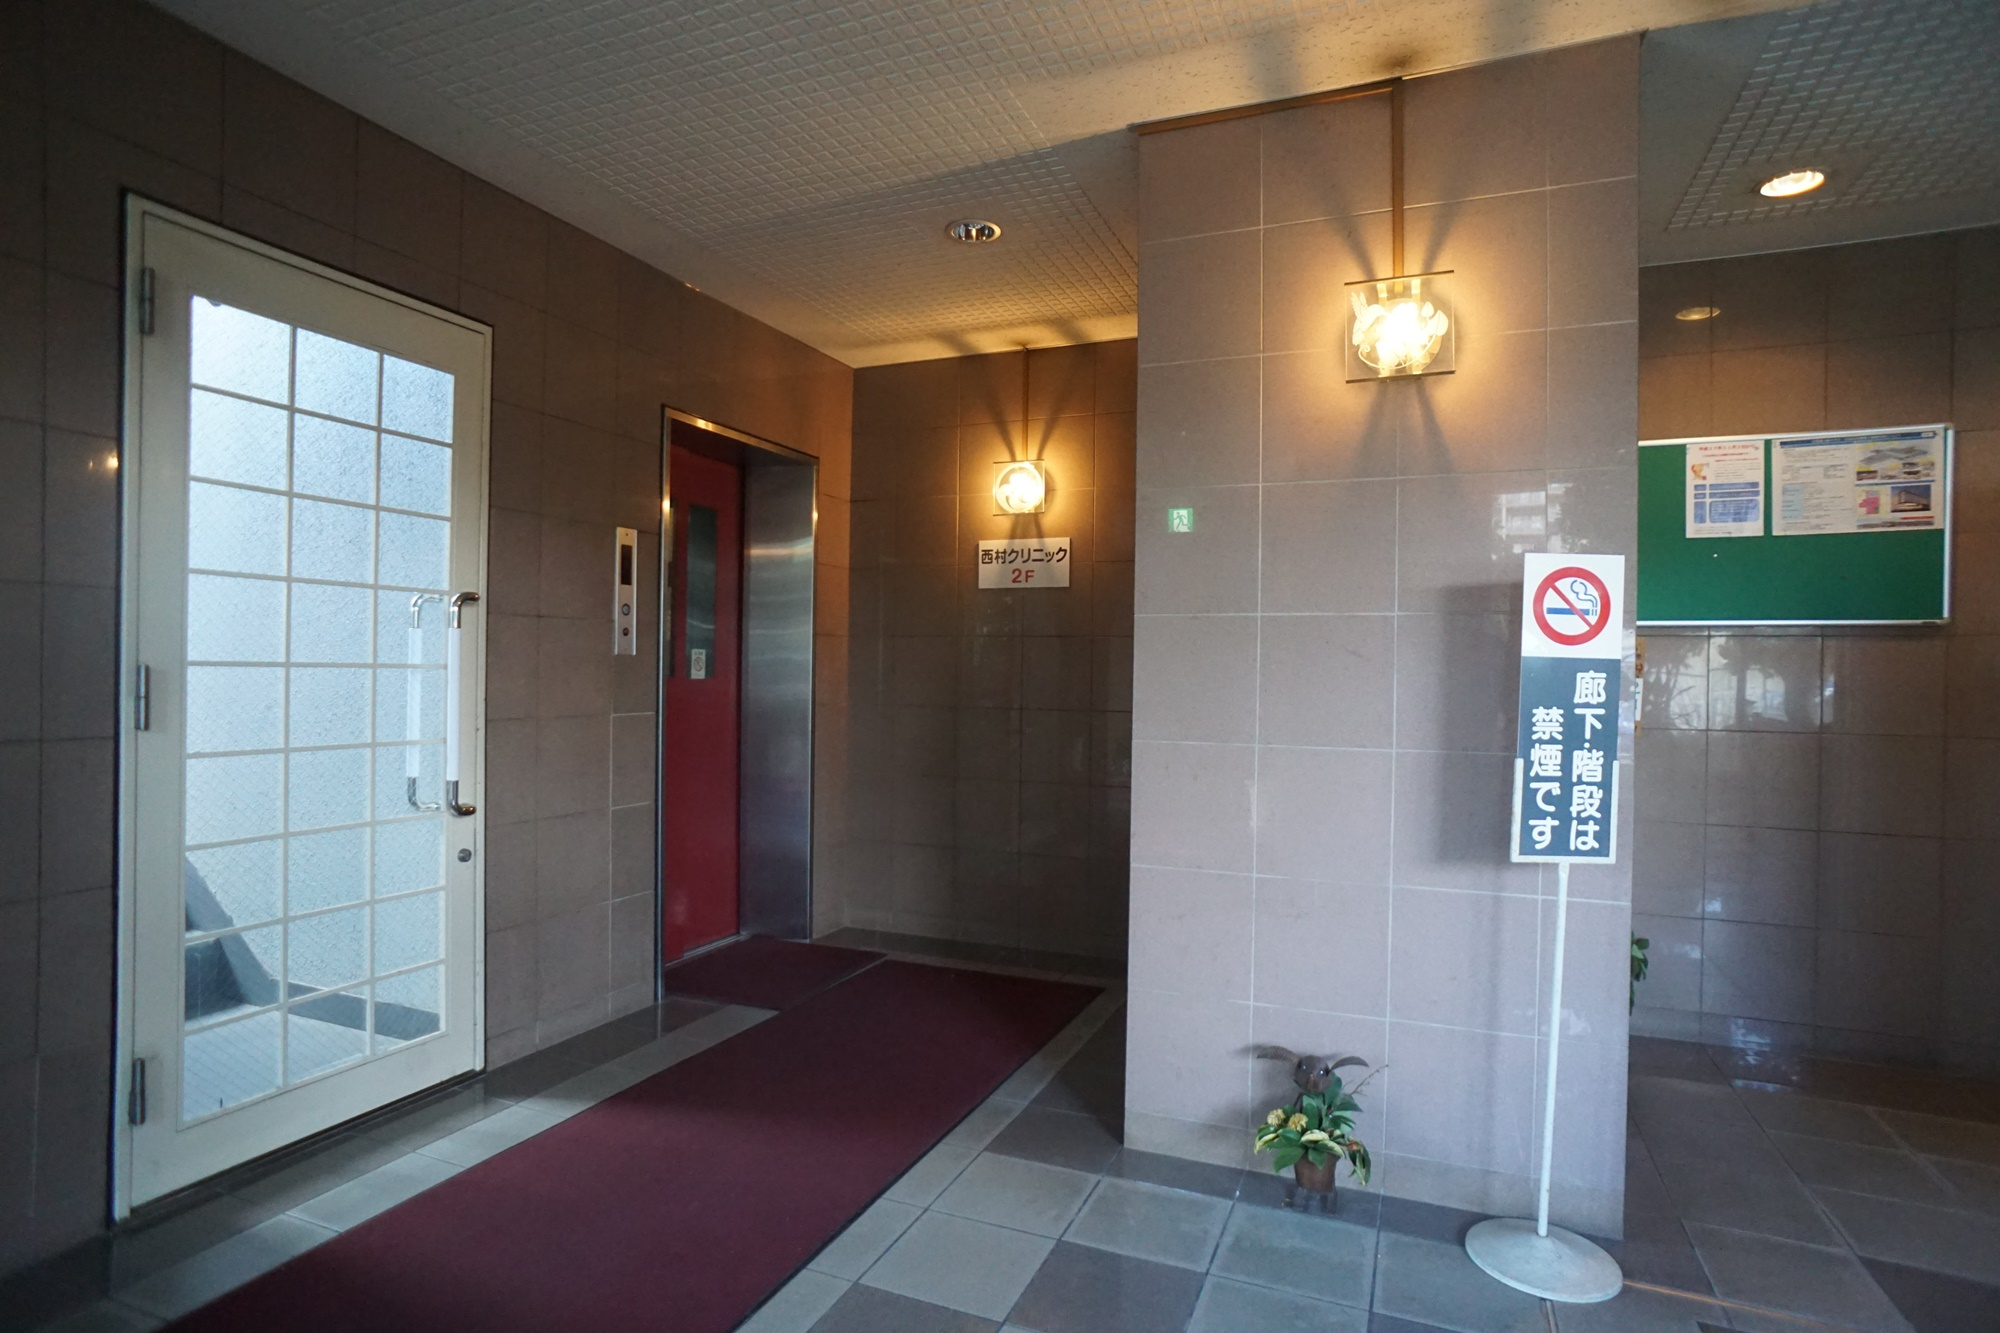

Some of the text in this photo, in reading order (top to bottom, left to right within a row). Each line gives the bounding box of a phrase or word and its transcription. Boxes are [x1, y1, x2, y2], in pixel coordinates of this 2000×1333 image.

[981, 547, 1067, 564] 西村クリニック
[1011, 568, 1035, 583] 2F
[1528, 706, 1564, 850] 禁煙です
